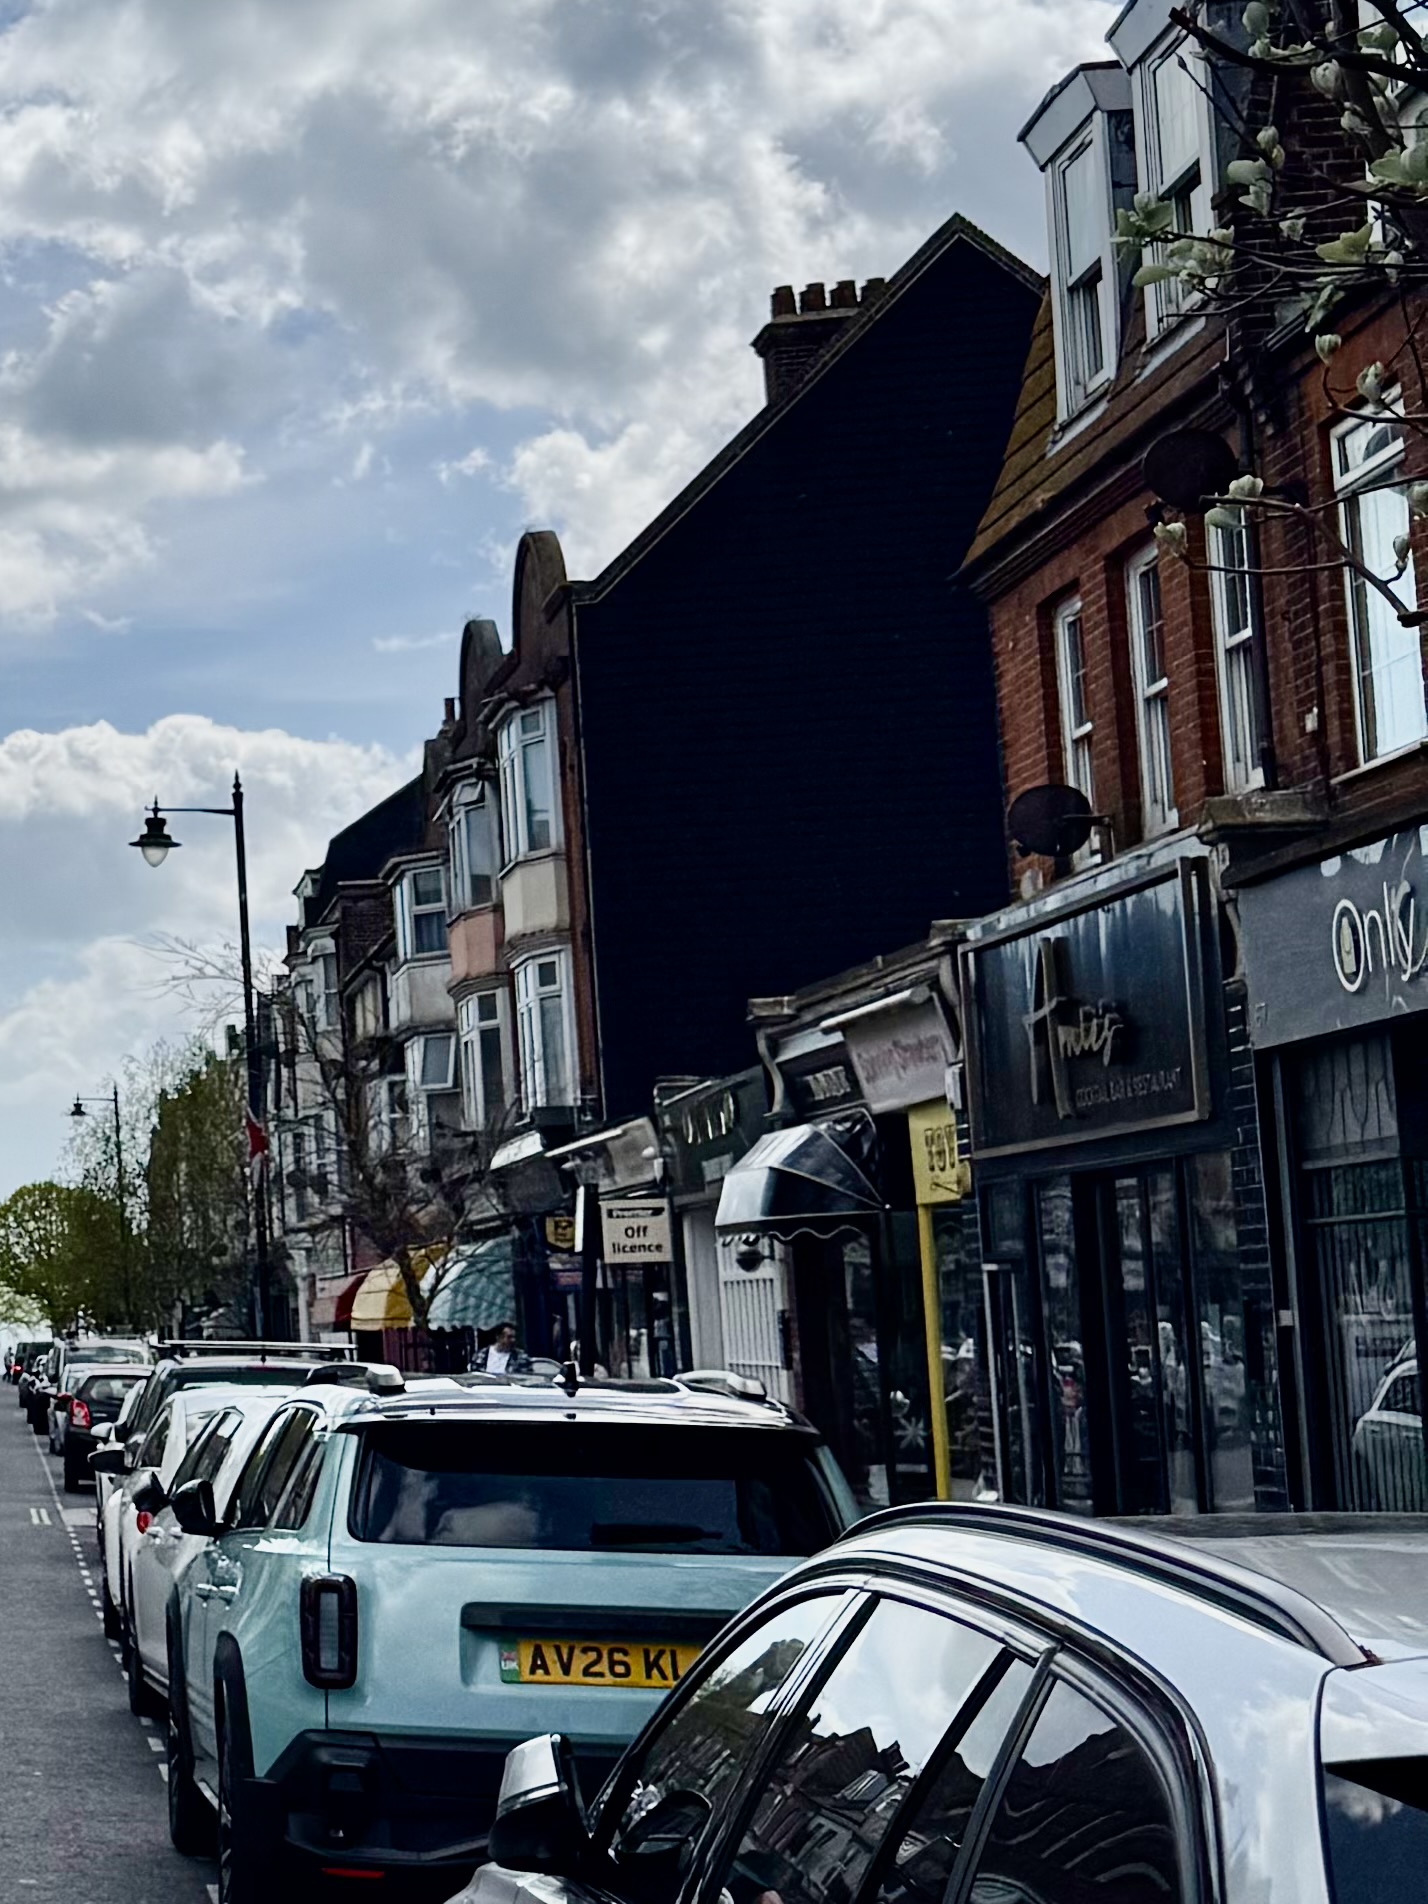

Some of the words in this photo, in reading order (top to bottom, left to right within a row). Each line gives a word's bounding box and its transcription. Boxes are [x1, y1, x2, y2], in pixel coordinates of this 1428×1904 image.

[625, 1225, 648, 1238] Off
[612, 1242, 663, 1254] licence
[529, 1643, 631, 1679] AV26
